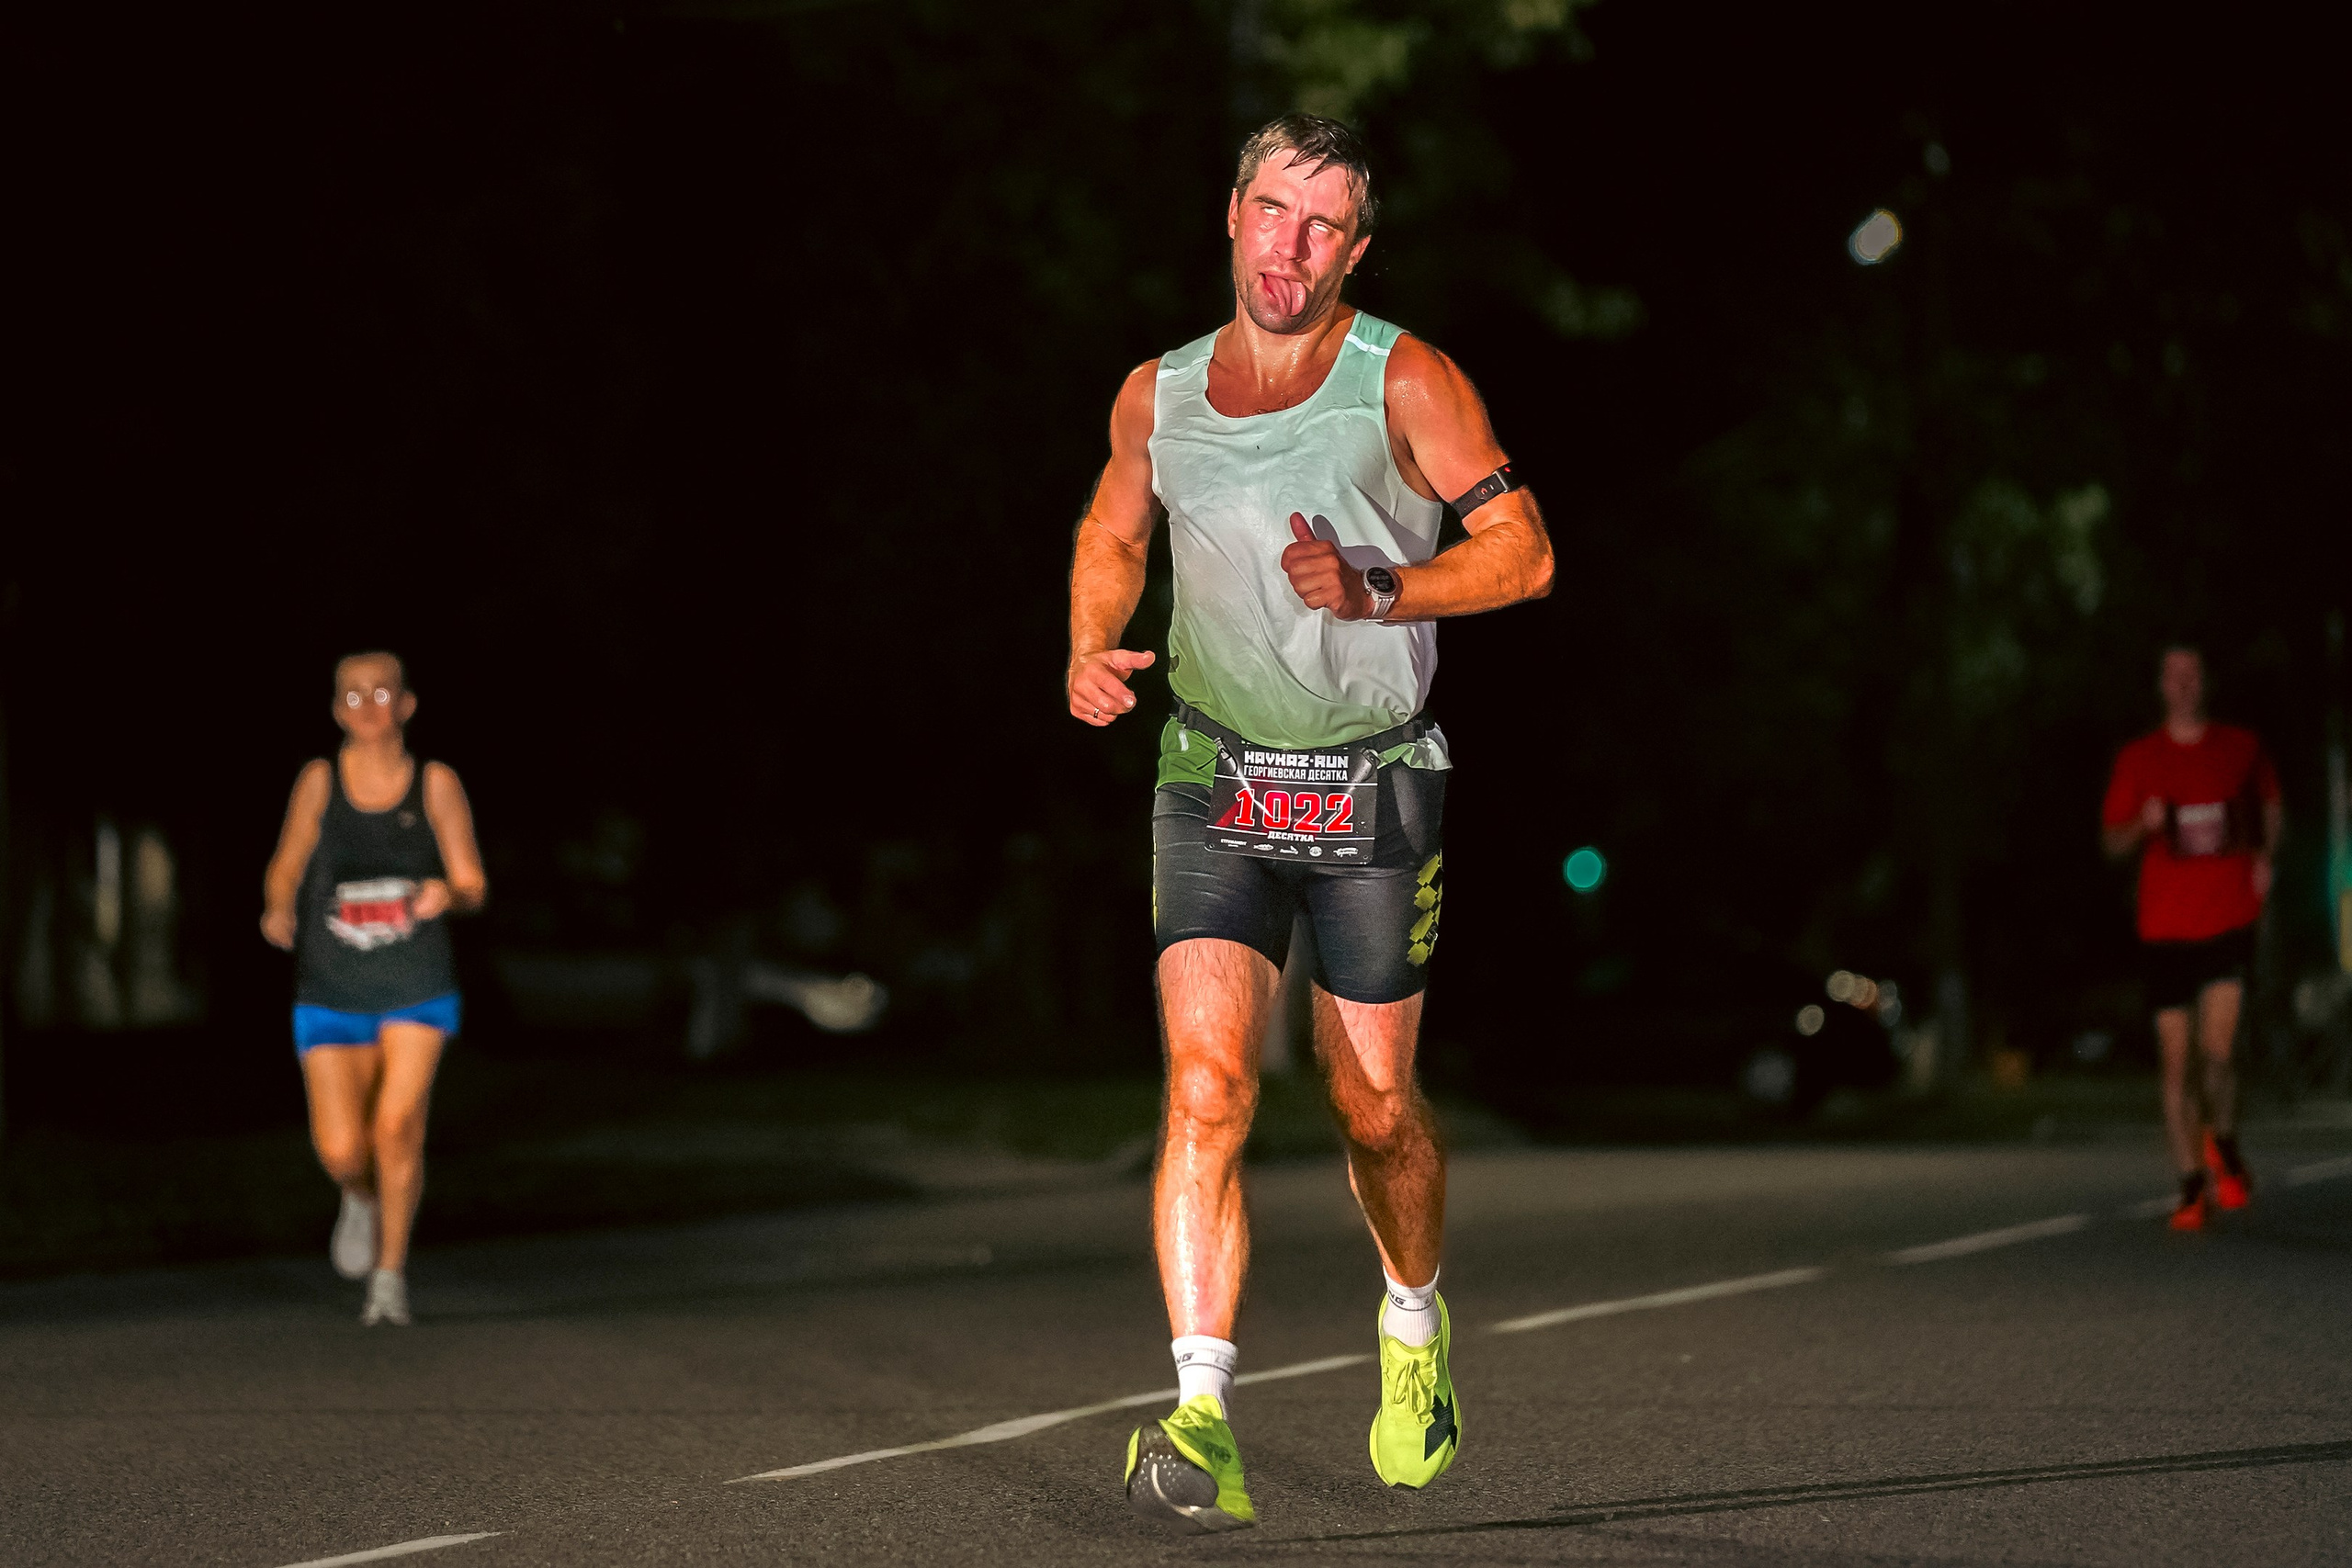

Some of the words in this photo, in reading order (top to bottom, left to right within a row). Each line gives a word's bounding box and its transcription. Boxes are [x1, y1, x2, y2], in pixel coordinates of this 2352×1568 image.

[1243, 765, 1306, 780] ГЕОРГИЕВСКАЯ
[1307, 768, 1348, 782] ДЕСЯТКА
[1235, 788, 1353, 833] 1022
[1267, 830, 1315, 842] ДЕСЯТКА
